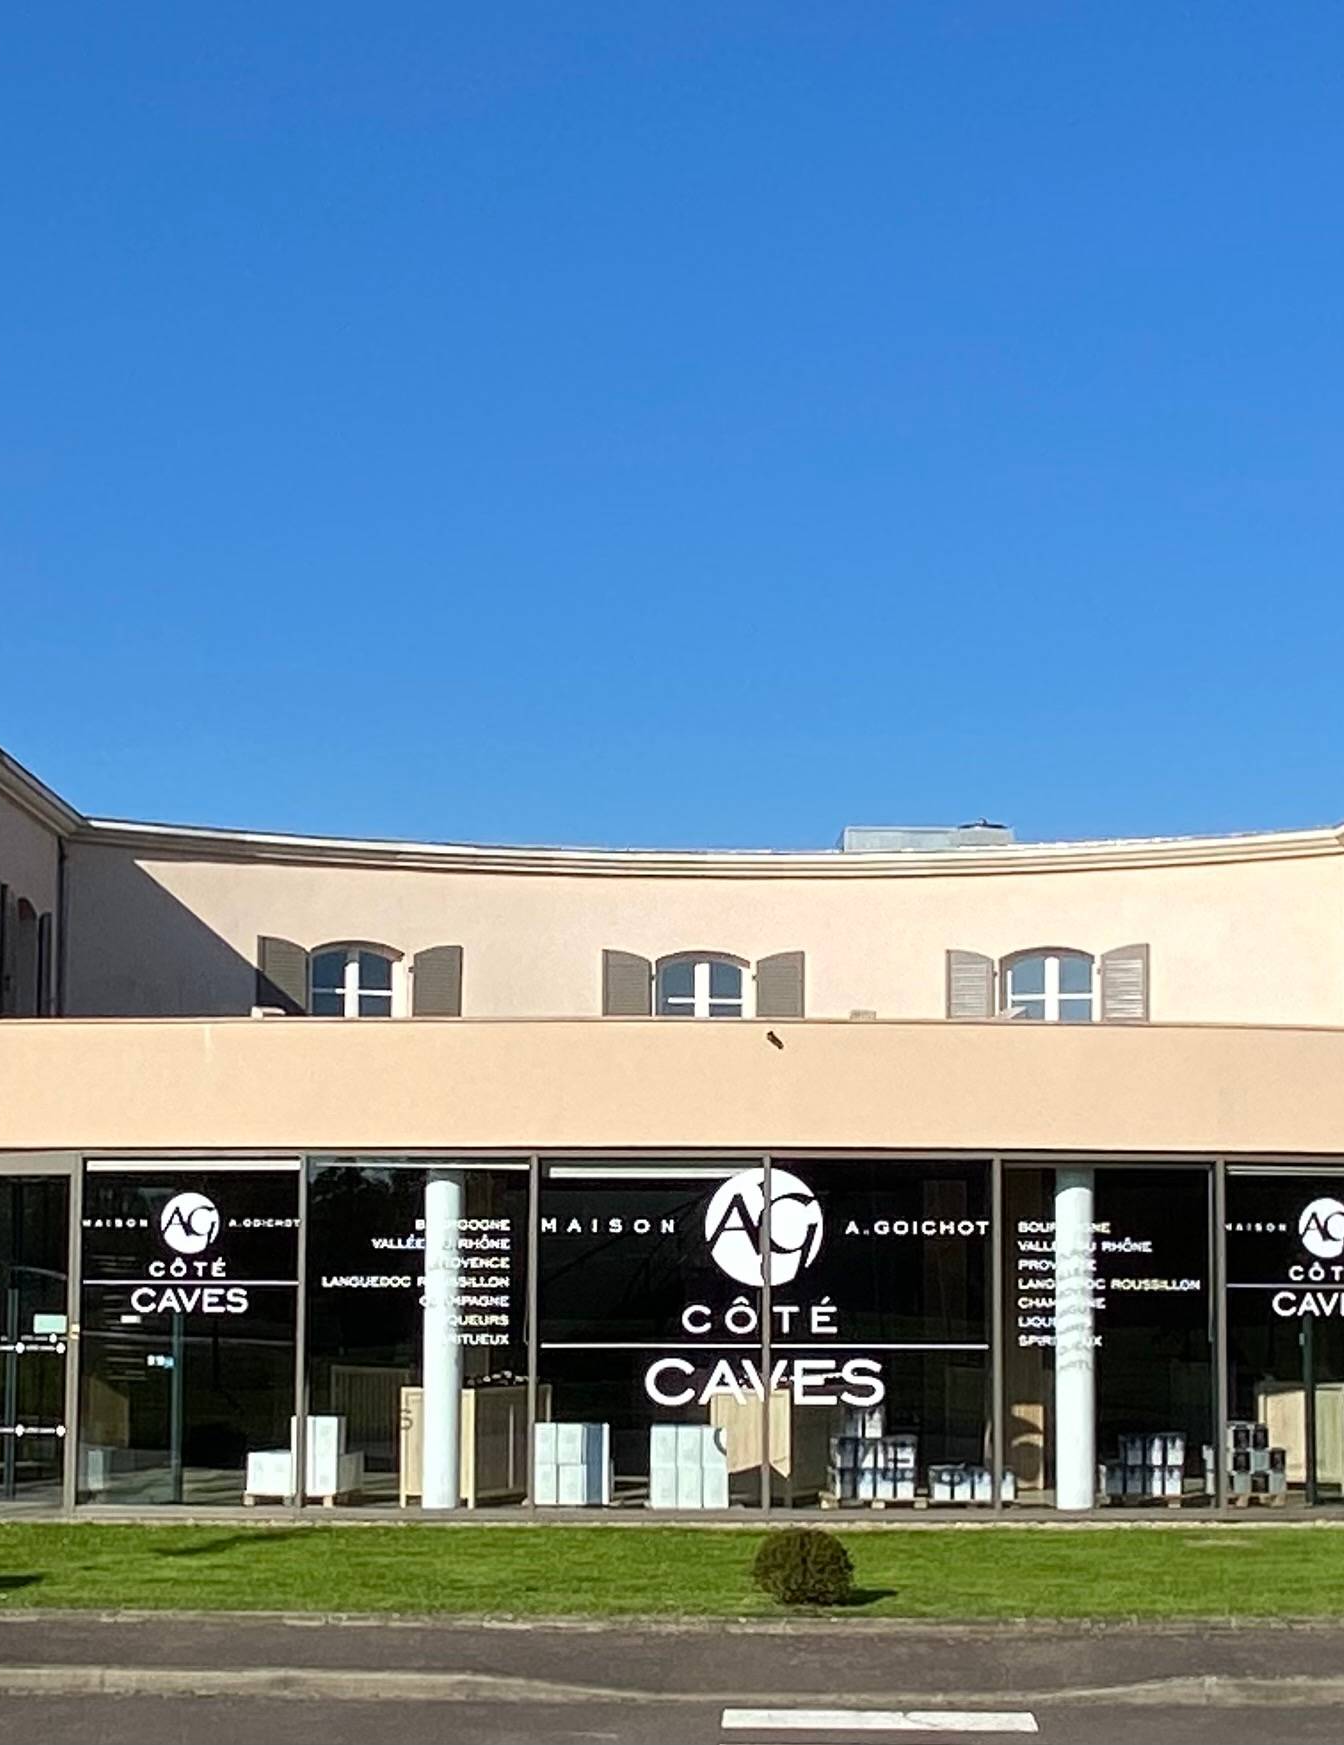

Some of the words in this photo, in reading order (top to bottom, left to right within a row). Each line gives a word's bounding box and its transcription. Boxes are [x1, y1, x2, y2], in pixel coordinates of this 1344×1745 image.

[83, 1219, 147, 1227] MAISON
[542, 1218, 674, 1233] MAISON
[846, 1221, 989, 1235] A.GOICHOT
[1102, 1237, 1152, 1252] RHÔNE
[149, 1257, 225, 1277] CÔTÉ
[322, 1276, 411, 1287] LANGUEDOC
[131, 1287, 248, 1316] CAVES
[682, 1294, 837, 1336] CÔTÉ
[645, 1358, 886, 1406] CAVES
